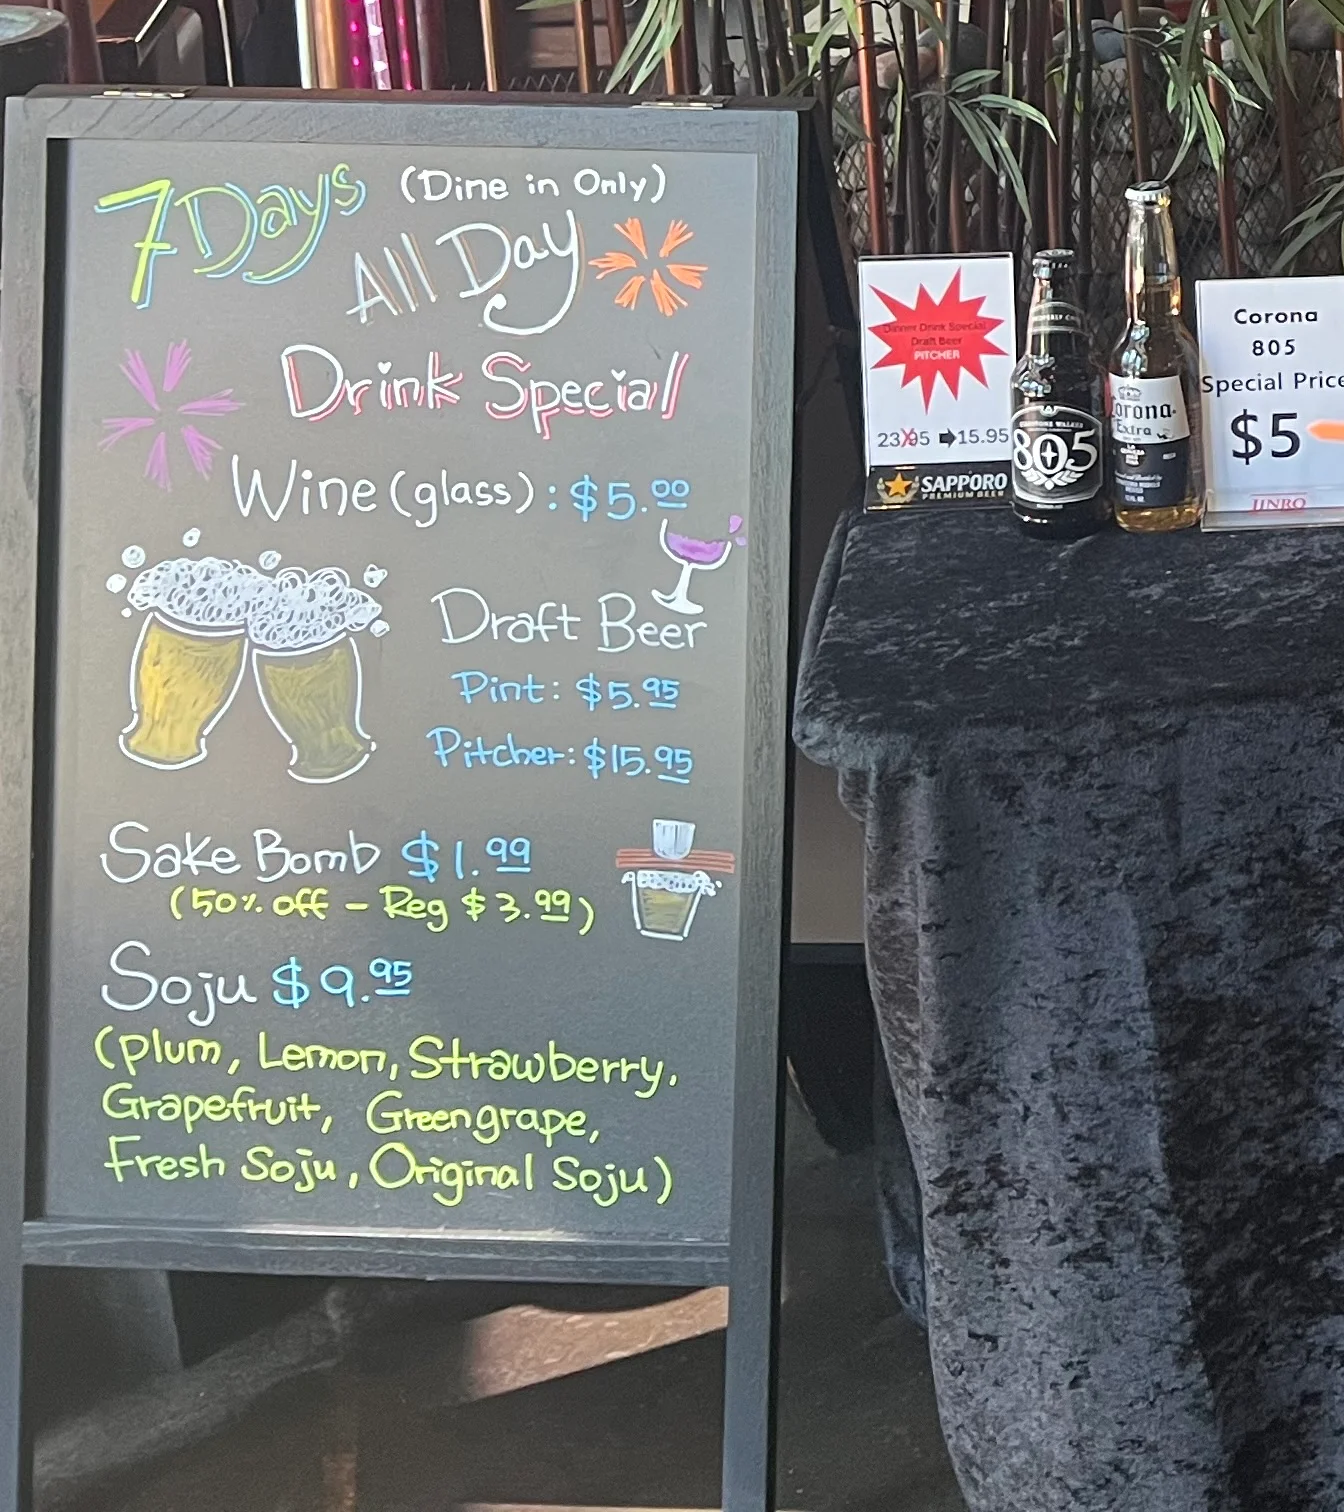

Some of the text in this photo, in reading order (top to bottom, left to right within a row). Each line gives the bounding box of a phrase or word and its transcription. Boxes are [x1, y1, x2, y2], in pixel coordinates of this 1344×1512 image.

[401, 164, 667, 204] (Dine in Only)
[346, 209, 585, 336] All Day
[1234, 308, 1318, 325] Corona
[914, 350, 960, 361] PITCHER
[1252, 339, 1296, 356] 805
[281, 344, 690, 441] Drink Special
[1202, 372, 1283, 397] Special
[957, 427, 1009, 445] 15.95
[1116, 419, 1152, 436] Extra
[1230, 409, 1301, 465] $5
[1013, 429, 1099, 475] 805
[231, 454, 378, 523] Wine
[921, 473, 1008, 493] SAPPORO
[922, 490, 974, 500] PREMIUM
[1252, 496, 1307, 511] JINRO
[430, 587, 708, 654] Draft Beer
[450, 670, 681, 713] Pint: $5.95
[425, 726, 694, 785] Pitcher: $15.95
[100, 820, 242, 884] Sake
[253, 828, 382, 884] Bomb
[169, 884, 264, 921] (50%
[271, 887, 330, 921] off
[378, 884, 450, 935] Reg
[100, 939, 259, 1029] Soju
[257, 1031, 400, 1081] Lemon,
[408, 1034, 681, 1101] Strawberry,
[101, 1082, 336, 1135] Grapefruit,
[103, 1135, 675, 1208] Fresh Soju, Original Soju)
